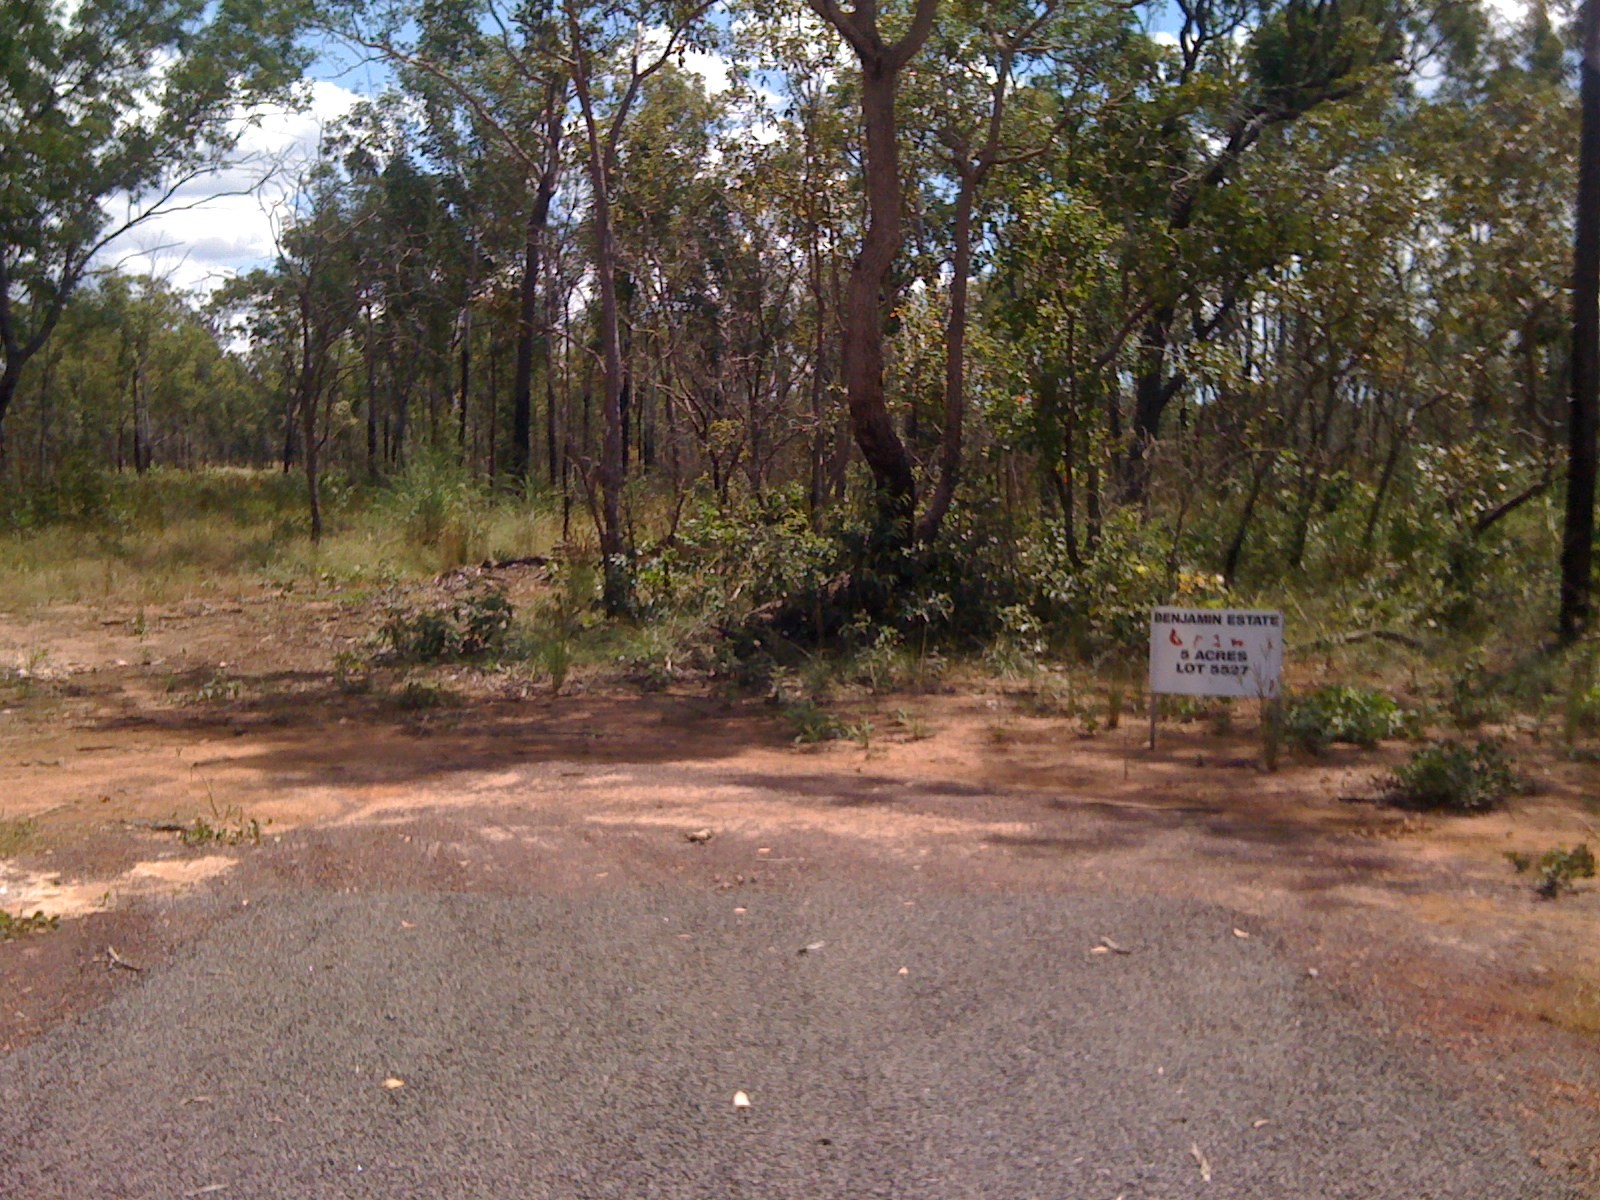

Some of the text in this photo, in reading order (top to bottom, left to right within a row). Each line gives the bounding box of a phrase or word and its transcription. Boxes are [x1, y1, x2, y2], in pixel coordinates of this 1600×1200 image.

[1154, 613, 1280, 626] BENJAMIN ESTATE
[1195, 650, 1247, 661] ACRES
[1176, 663, 1205, 674] LOT
